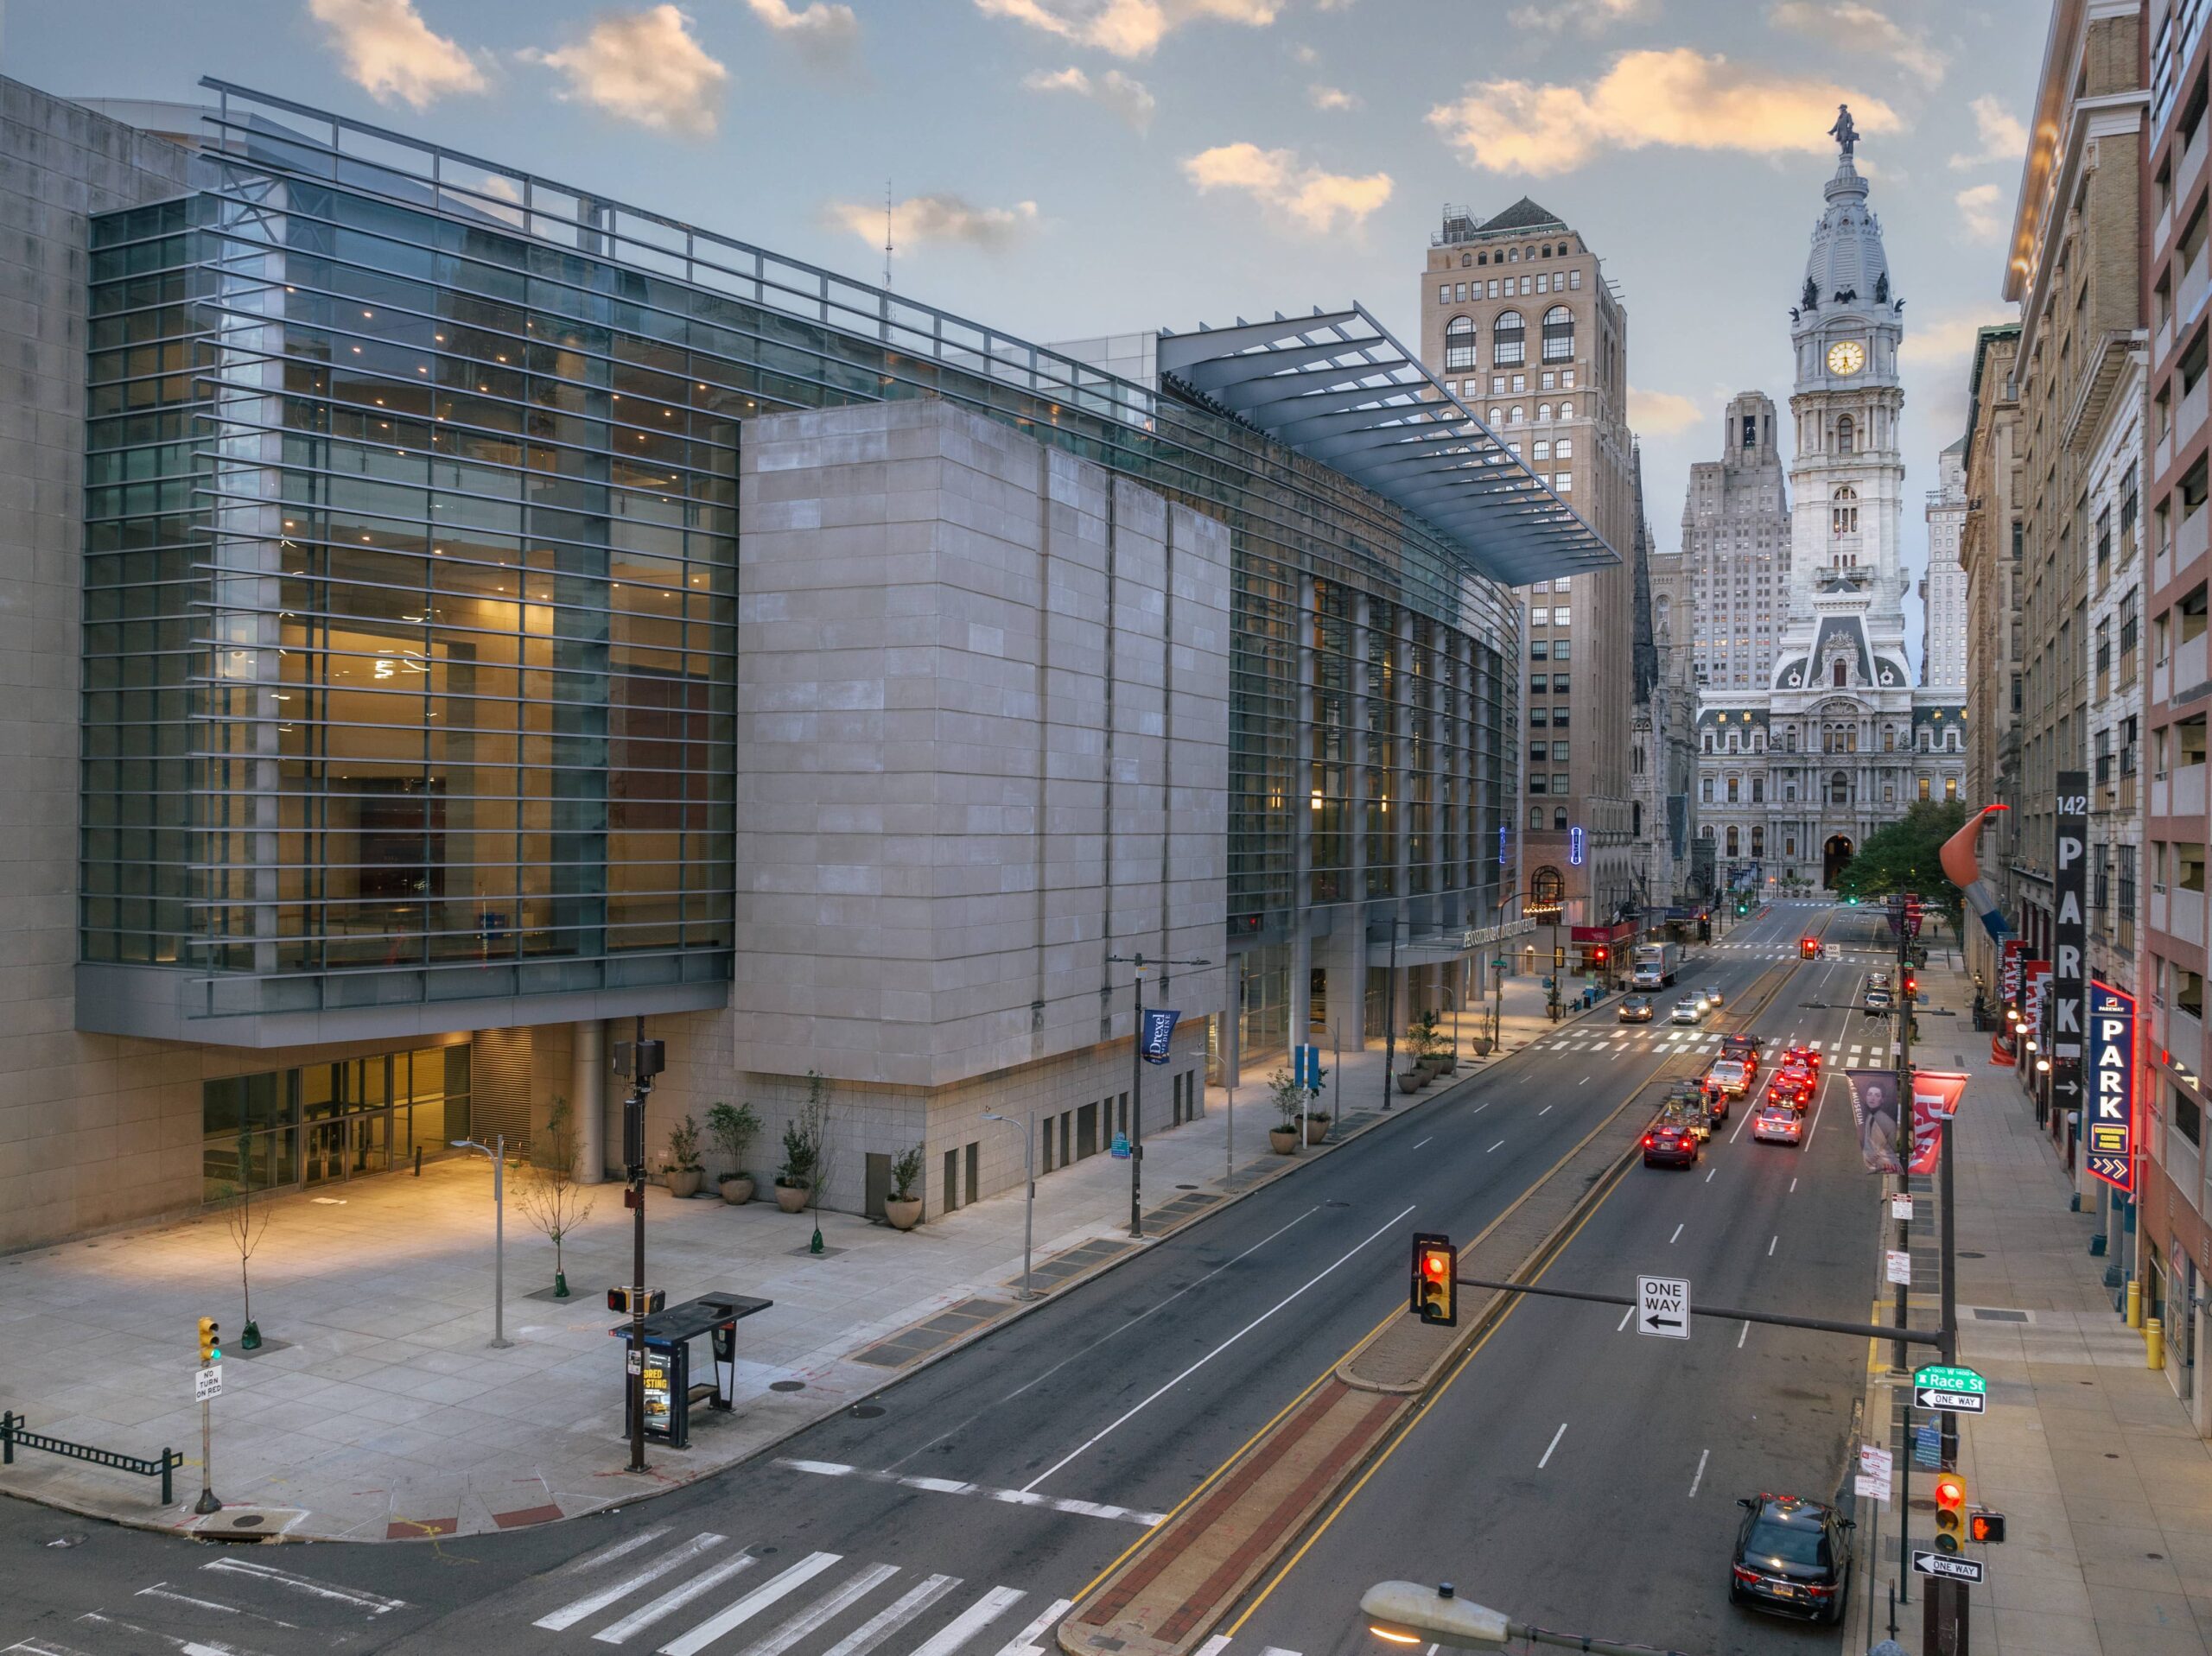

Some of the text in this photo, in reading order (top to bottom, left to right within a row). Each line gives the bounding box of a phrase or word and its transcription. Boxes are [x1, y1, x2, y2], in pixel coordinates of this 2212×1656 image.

[2056, 796, 2087, 815] 142
[2056, 836, 2082, 1033] PARK
[1150, 1014, 1165, 1054] Drexel
[2099, 1019, 2124, 1119] PARK
[1852, 1092, 1864, 1126] MUSEUM
[1645, 1282, 1681, 1298] ONE
[1645, 1297, 1681, 1312] WAY
[200, 1377, 219, 1388] TURN
[204, 1370, 213, 1379] NO
[1930, 1374, 1984, 1391] Race St
[196, 1385, 221, 1399] ON RED
[644, 1379, 667, 1389] STING
[1935, 1394, 1975, 1406] ONE WAY
[1933, 1560, 1975, 1576] ONE WAY
